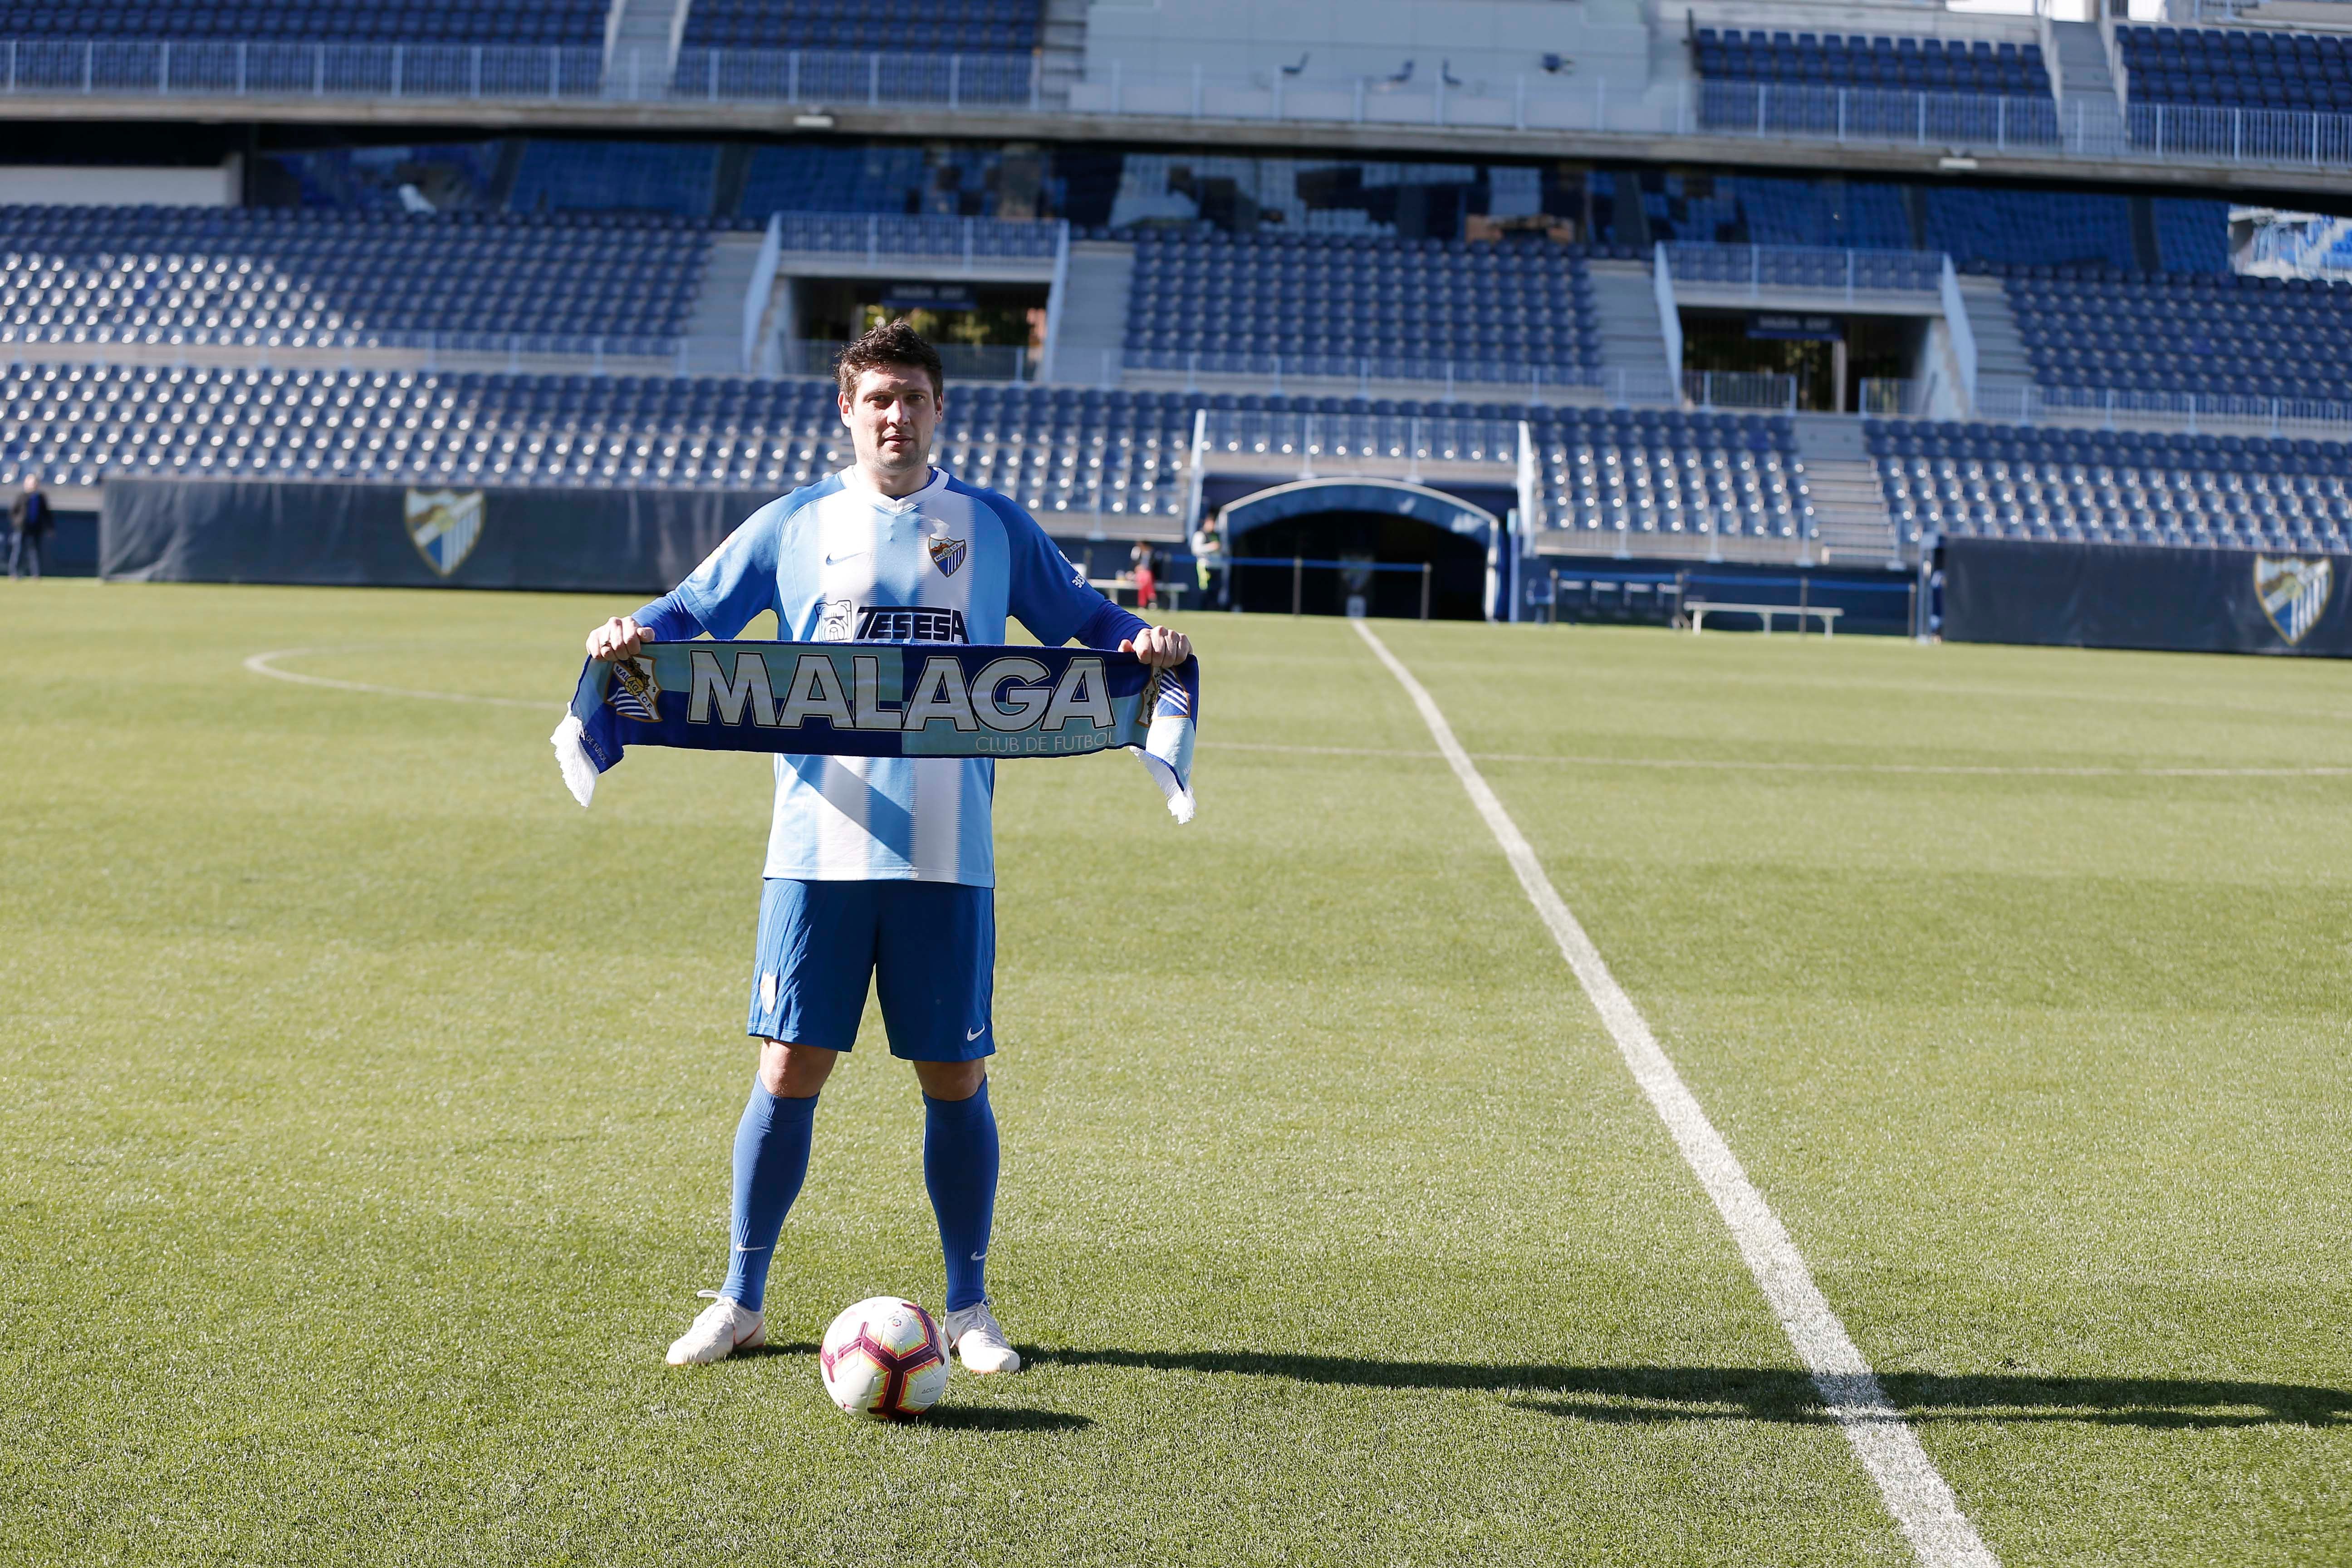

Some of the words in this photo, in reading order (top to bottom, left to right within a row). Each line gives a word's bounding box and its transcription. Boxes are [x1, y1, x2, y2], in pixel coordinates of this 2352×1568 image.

[857, 606, 970, 644] TESESA
[687, 650, 1116, 731] MALAGA
[586, 735, 594, 745] DE
[976, 736, 1019, 752] CLUB
[1026, 737, 1047, 751] DE
[1055, 731, 1115, 751] FUTBOL
